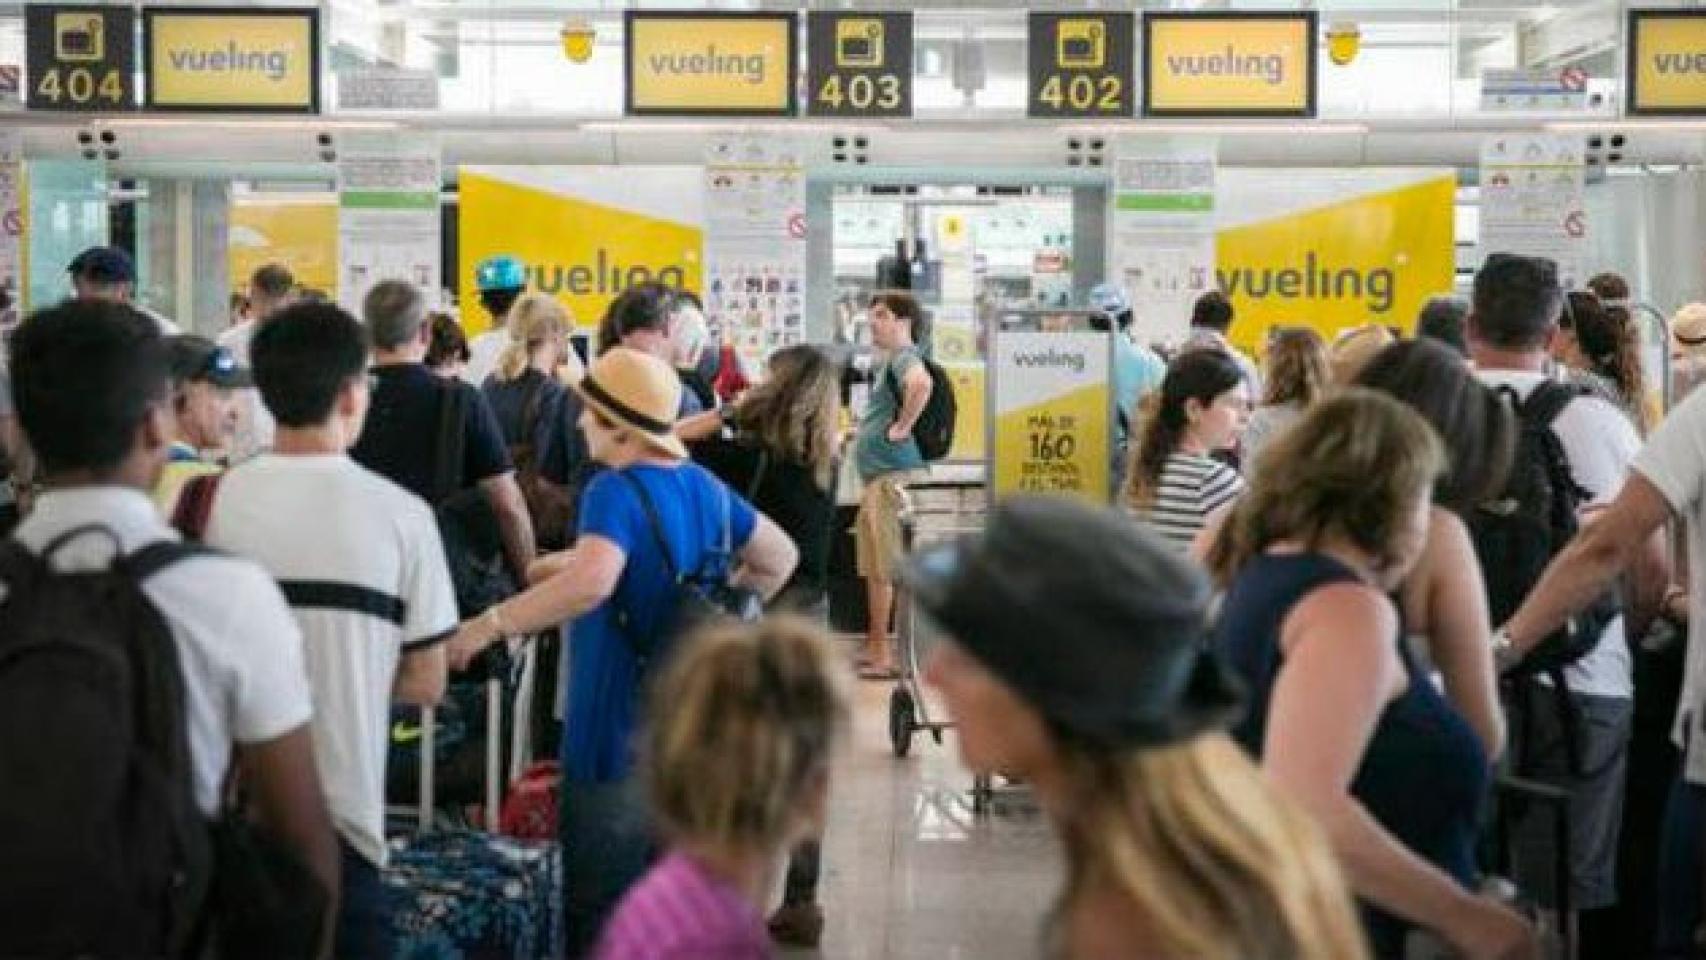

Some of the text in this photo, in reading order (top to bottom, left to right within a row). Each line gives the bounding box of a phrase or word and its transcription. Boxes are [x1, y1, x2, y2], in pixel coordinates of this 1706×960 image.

[169, 41, 287, 78] vueling
[650, 46, 765, 81] vueling
[1168, 45, 1284, 83] vueling
[38, 68, 123, 102] 404
[820, 75, 900, 109] 403
[1039, 75, 1122, 109] 402
[1215, 250, 1395, 313] vueling
[1014, 348, 1085, 372] vueling
[1030, 432, 1076, 461] 160
